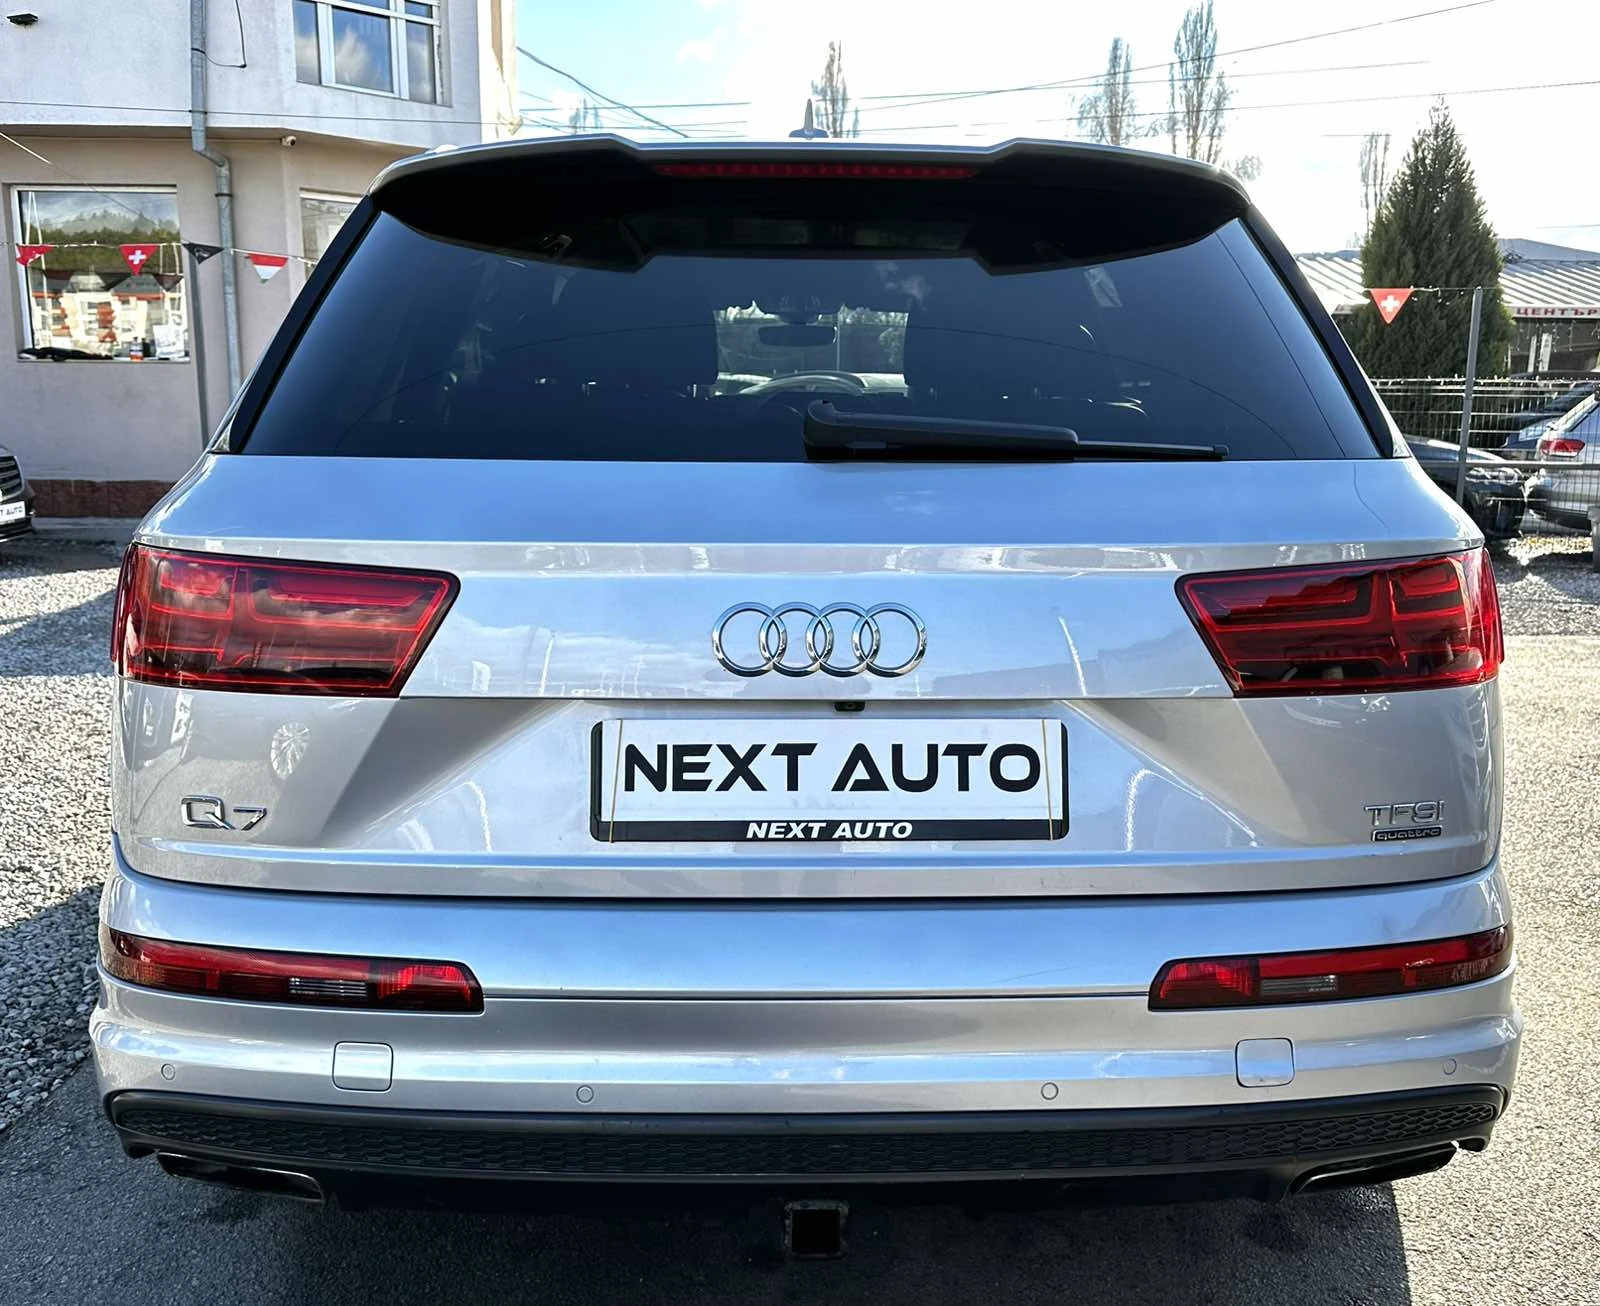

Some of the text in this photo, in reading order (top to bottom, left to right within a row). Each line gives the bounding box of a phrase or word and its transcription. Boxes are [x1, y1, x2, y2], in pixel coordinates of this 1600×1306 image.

[1516, 307, 1598, 316] ЦЕНТЪР
[624, 743, 1041, 793] NEXT AUTO
[181, 795, 267, 831] Q7
[1364, 800, 1445, 826] TFSI
[746, 822, 913, 839] NEXT AUTO
[1376, 828, 1440, 841] quattro
